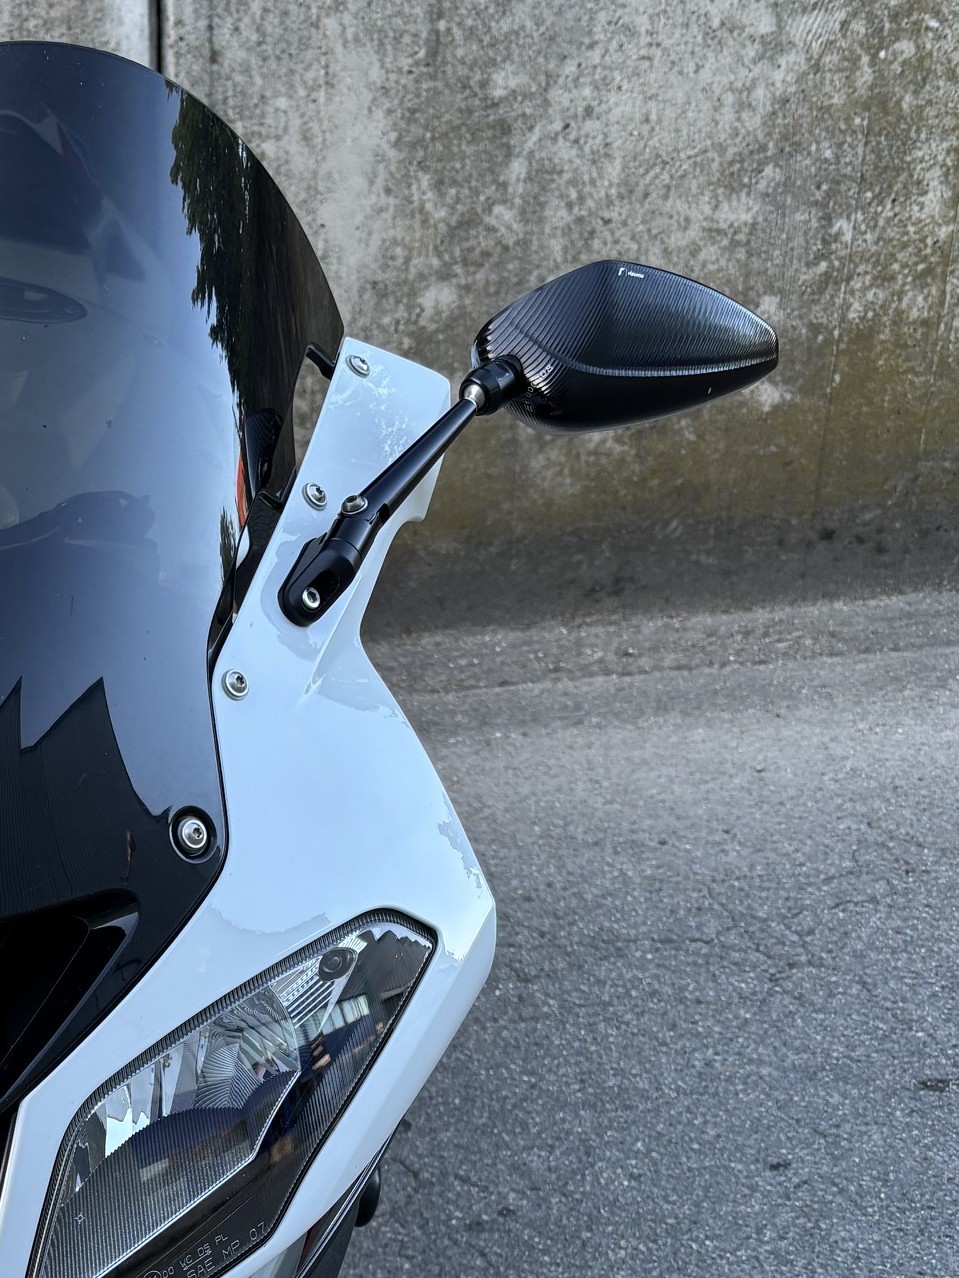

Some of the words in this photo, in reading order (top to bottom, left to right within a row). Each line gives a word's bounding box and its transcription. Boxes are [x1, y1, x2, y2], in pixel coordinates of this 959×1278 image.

[162, 1266, 174, 1278] 00
[214, 1233, 228, 1245] PL
[222, 1239, 240, 1259] MP
[249, 1221, 266, 1241] 07
